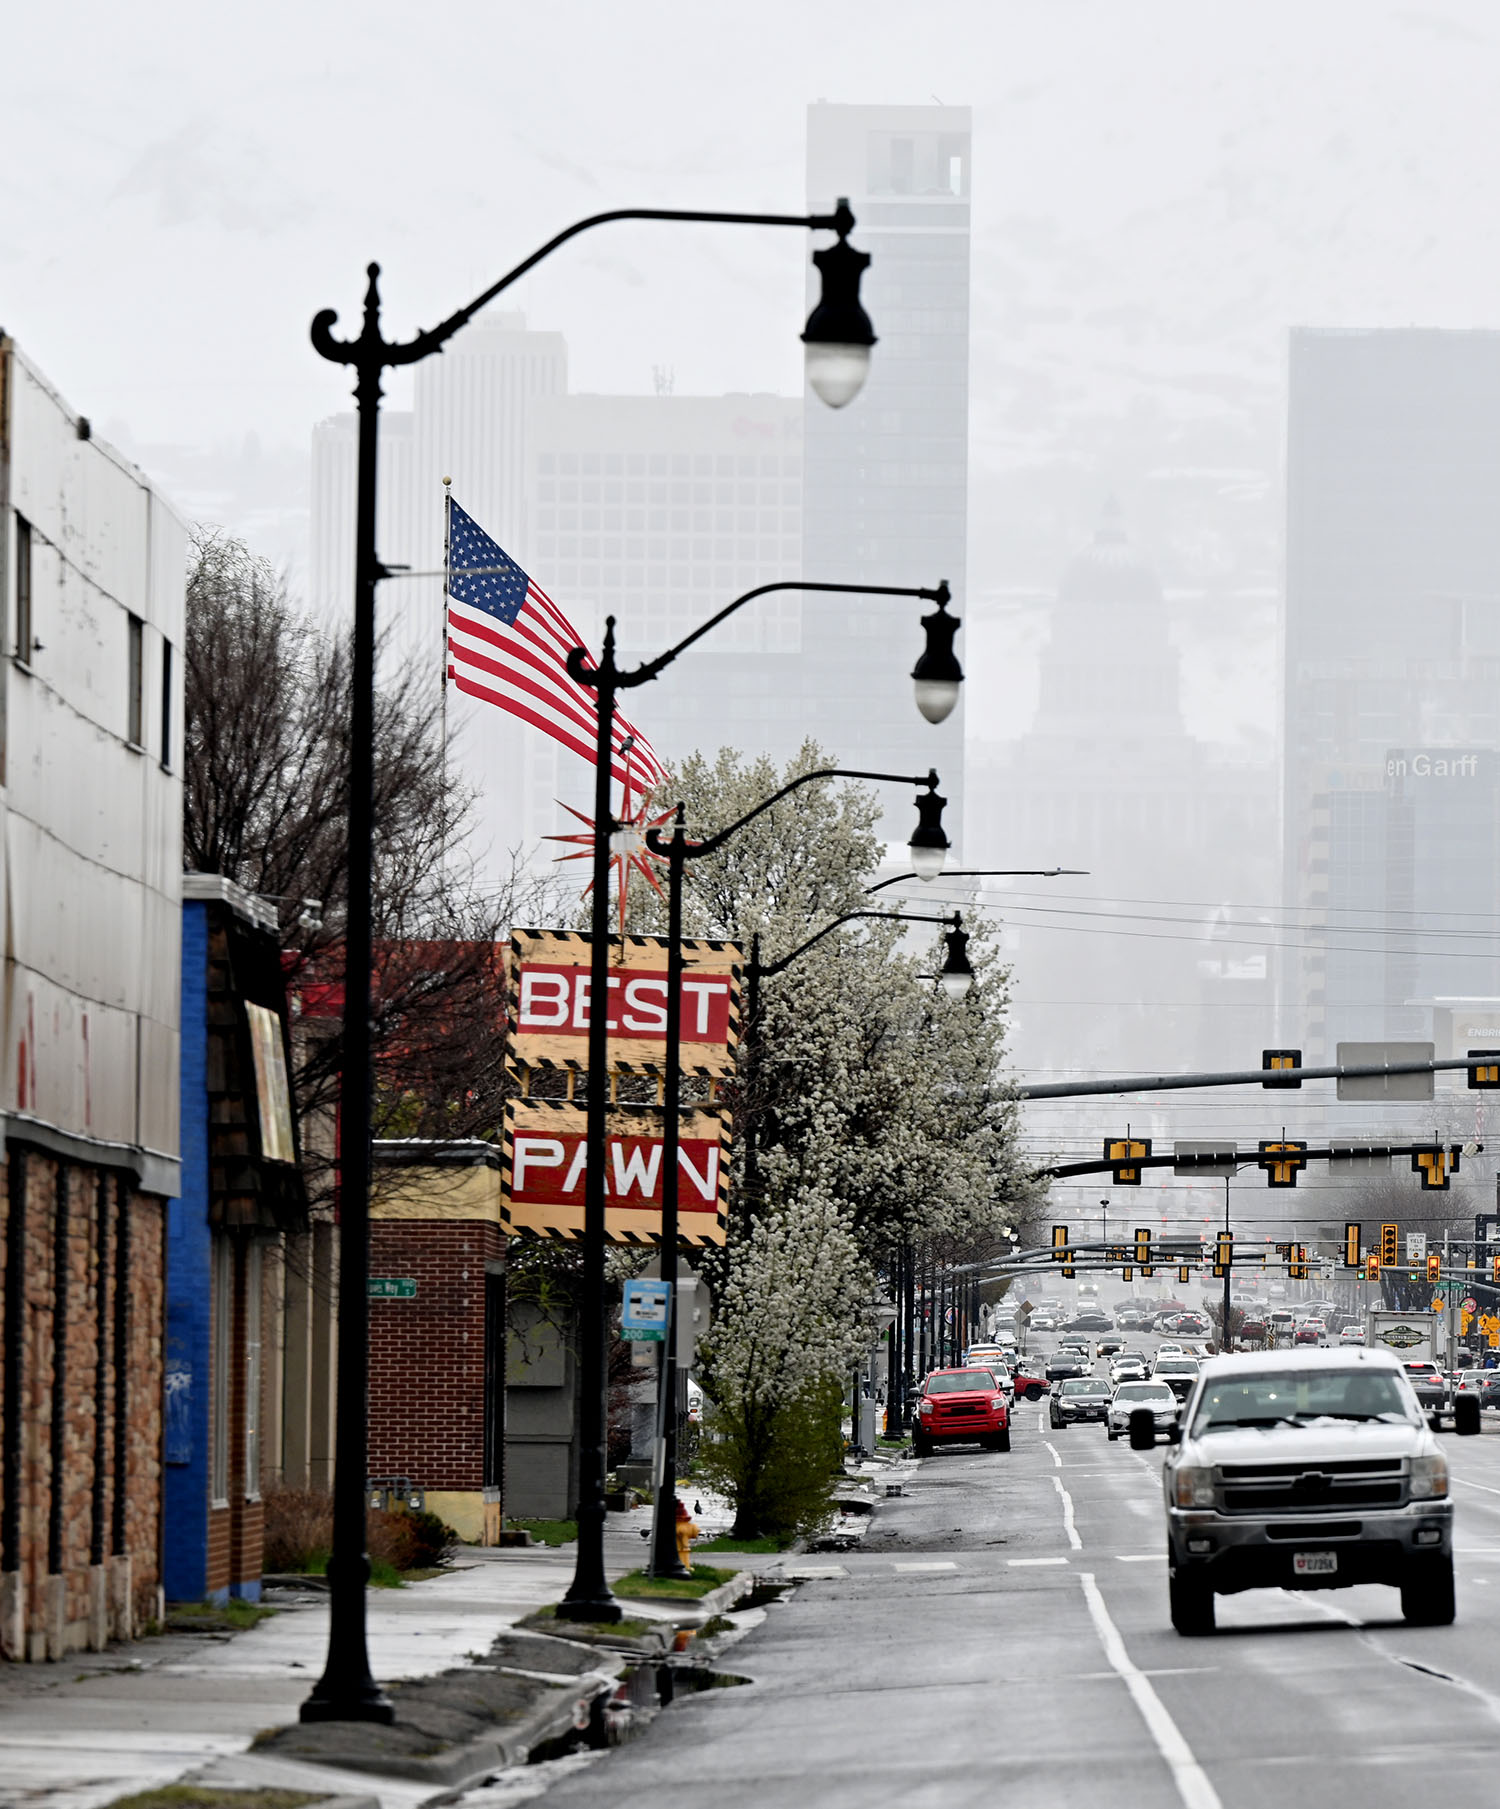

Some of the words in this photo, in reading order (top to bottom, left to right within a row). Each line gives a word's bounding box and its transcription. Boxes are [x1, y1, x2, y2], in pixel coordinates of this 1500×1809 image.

[1411, 753, 1478, 777] Garff
[518, 971, 728, 1034] BEST
[512, 1137, 720, 1202] PAWN
[622, 1330, 644, 1340] 200
